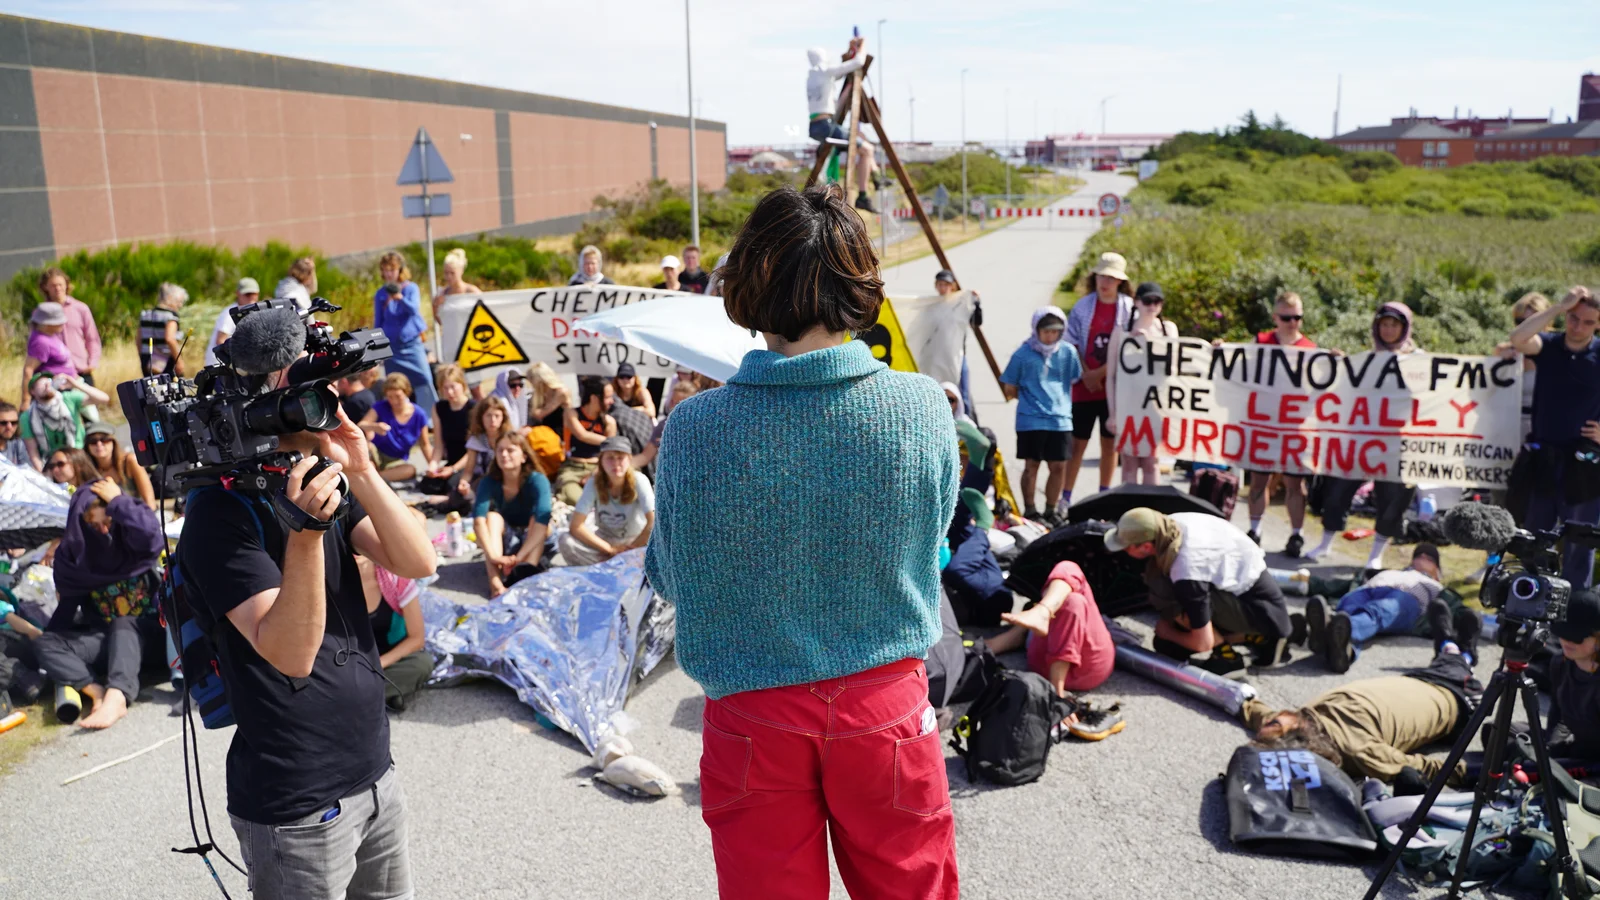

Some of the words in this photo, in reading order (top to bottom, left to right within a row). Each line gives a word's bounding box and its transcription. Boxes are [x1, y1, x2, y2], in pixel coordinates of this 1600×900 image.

[1119, 337, 1406, 389] CHEMINOVA
[1429, 357, 1516, 391] FMC
[1142, 386, 1210, 412] ARE
[1247, 391, 1478, 428] LEGALLY
[1116, 415, 1388, 476] MURDERING
[1400, 439, 1446, 455] SOUTH
[1453, 442, 1514, 461] AFRICAN
[1398, 460, 1512, 484] FARMWORKERS
